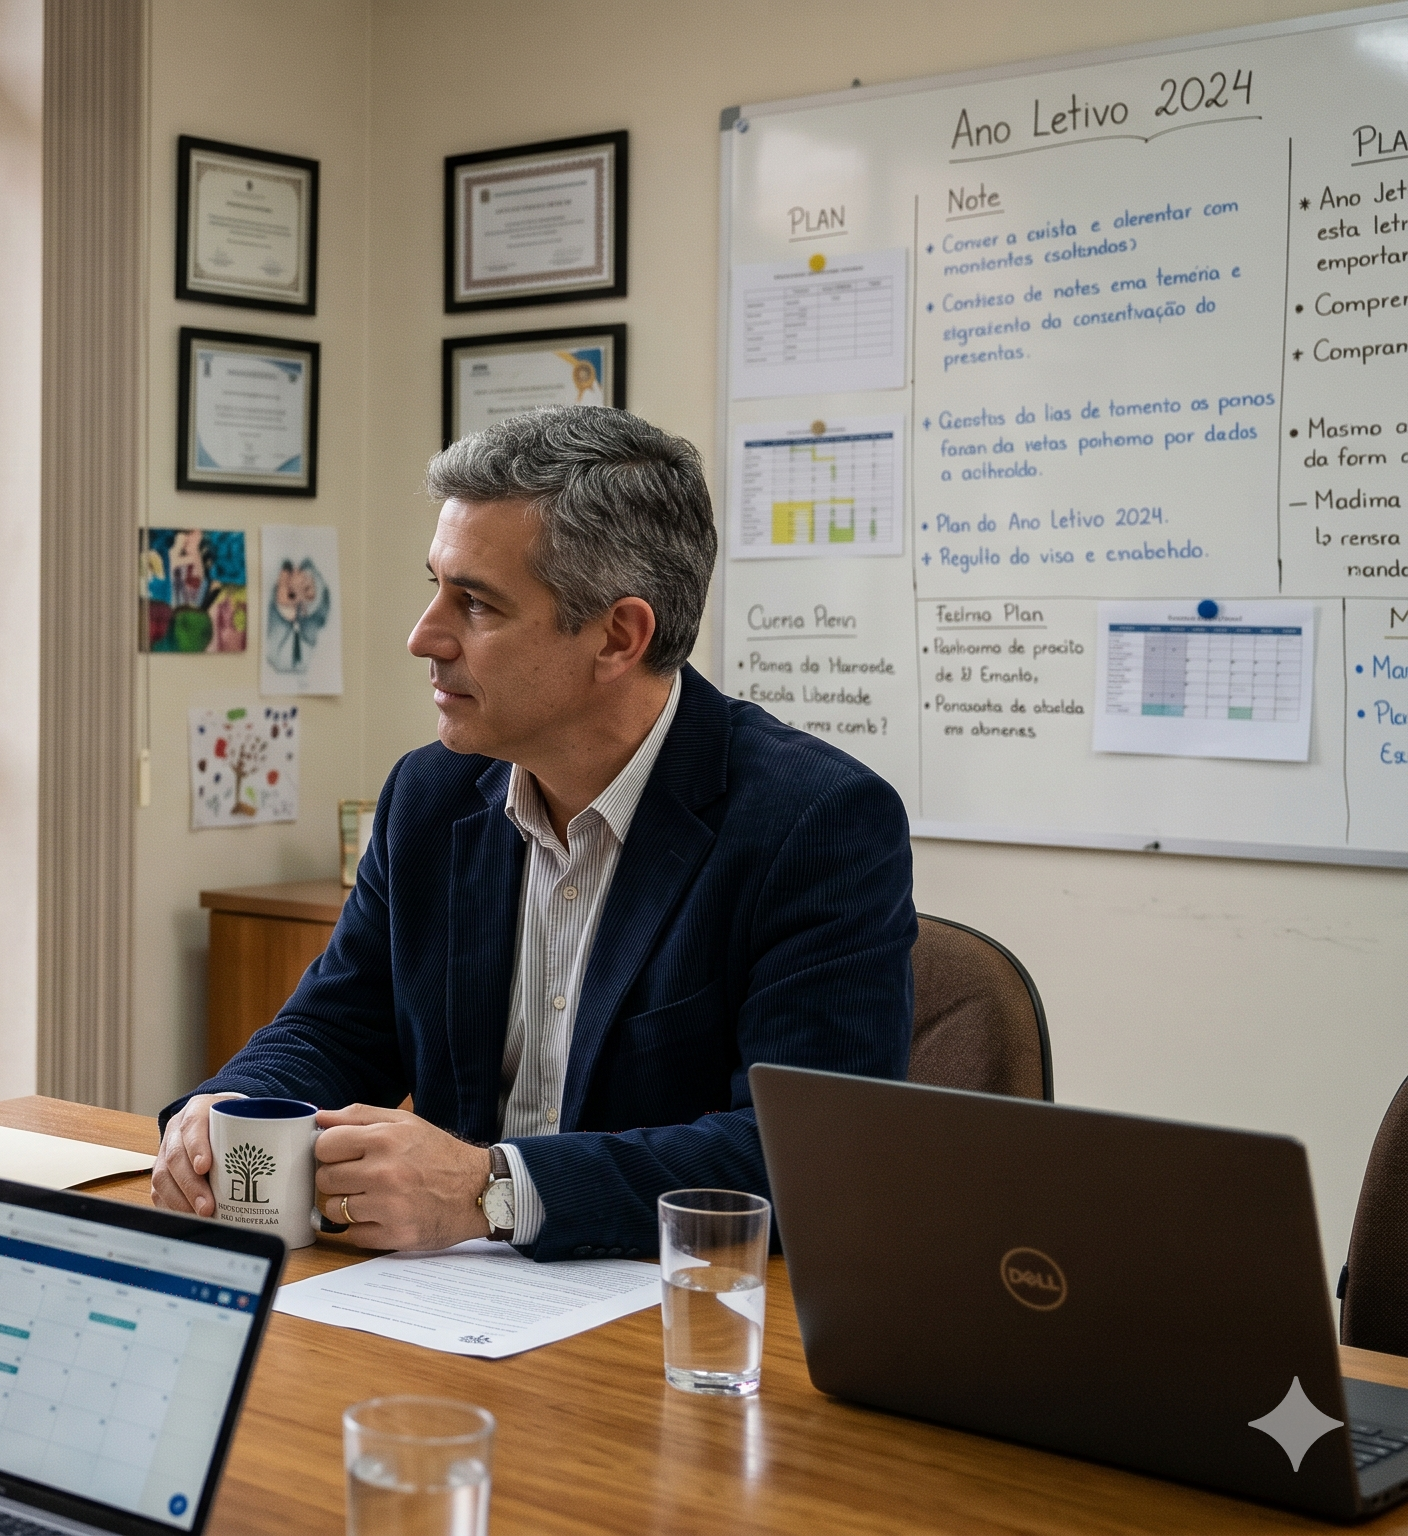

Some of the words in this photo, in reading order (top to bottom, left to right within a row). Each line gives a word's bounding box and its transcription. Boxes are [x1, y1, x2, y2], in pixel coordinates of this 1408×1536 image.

[951, 108, 1011, 149] Ano
[1033, 94, 1129, 137] Letivo
[1154, 70, 1254, 117] 2024
[948, 183, 1001, 215] Note
[1319, 185, 1361, 210] Ano
[788, 205, 846, 235] PLAN
[1006, 233, 1017, 246] a
[1090, 220, 1101, 232] e
[1203, 201, 1239, 216] com
[1317, 218, 1360, 241] esta
[1023, 284, 1042, 303] de
[1054, 278, 1100, 299] notes
[1231, 265, 1241, 279] e
[1196, 295, 1216, 314] do
[1080, 400, 1100, 420] de
[1308, 416, 1382, 439] Masmo
[1164, 432, 1195, 450] por
[1304, 448, 1328, 468] da
[1338, 446, 1387, 467] form
[1315, 488, 1401, 510] Madima
[936, 512, 971, 533] Plan
[977, 513, 997, 533] do
[1008, 512, 1041, 531] Ano
[1050, 508, 1105, 529] Letivo
[1115, 506, 1169, 527] 2024.
[1009, 545, 1030, 566] do
[1040, 548, 1075, 564] visa
[1085, 551, 1096, 563] e
[1003, 602, 1044, 622] Plan
[749, 682, 795, 702] Escola
[802, 684, 872, 706] Liberdade
[1008, 1266, 1061, 1291] DELL
